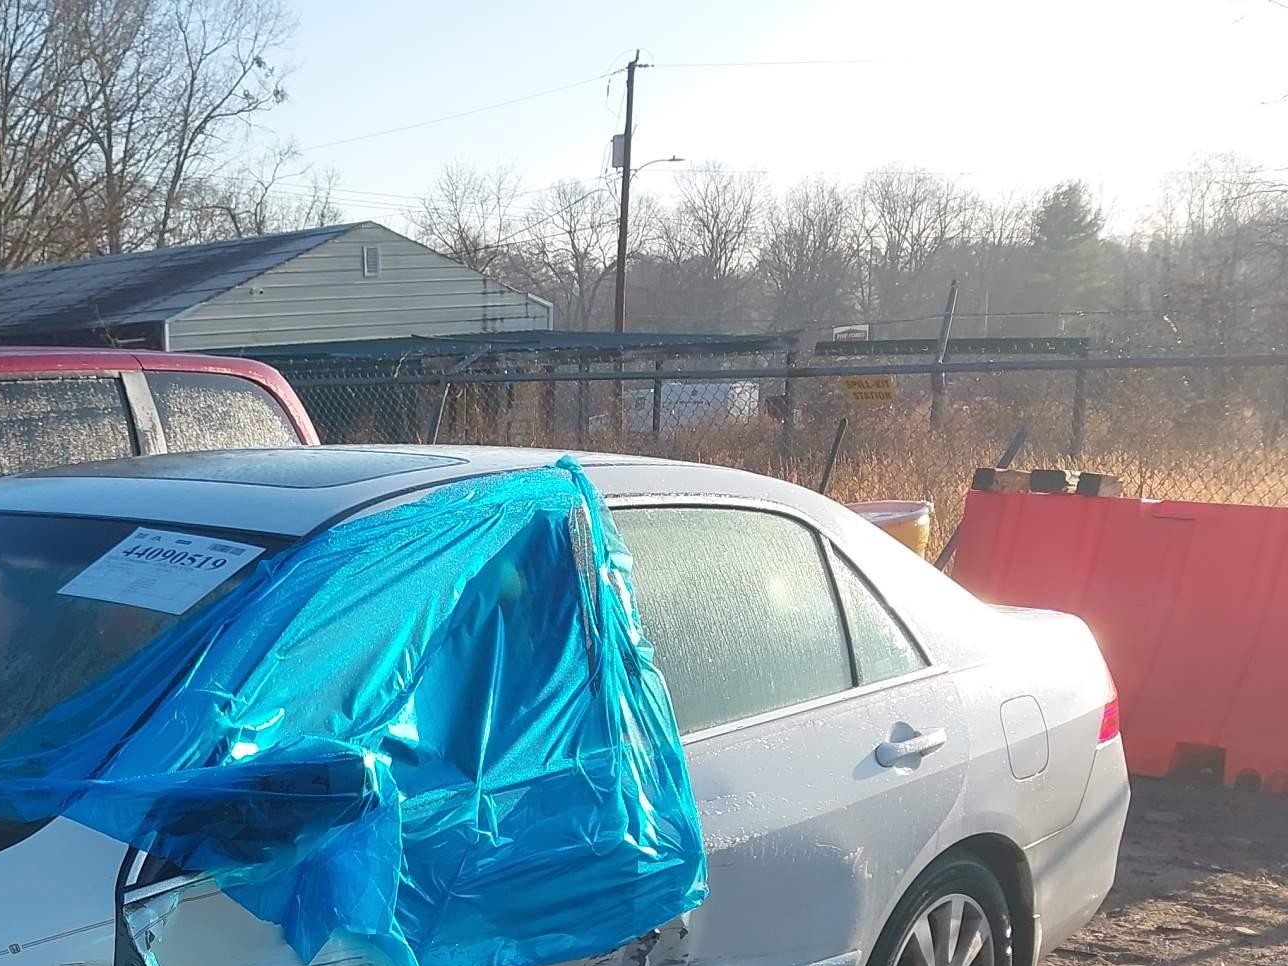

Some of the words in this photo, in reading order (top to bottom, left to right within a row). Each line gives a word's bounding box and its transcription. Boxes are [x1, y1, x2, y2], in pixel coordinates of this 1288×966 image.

[845, 380, 890, 389] SPILL-KIT
[853, 392, 893, 400] STATION
[122, 544, 227, 571] 44090519
